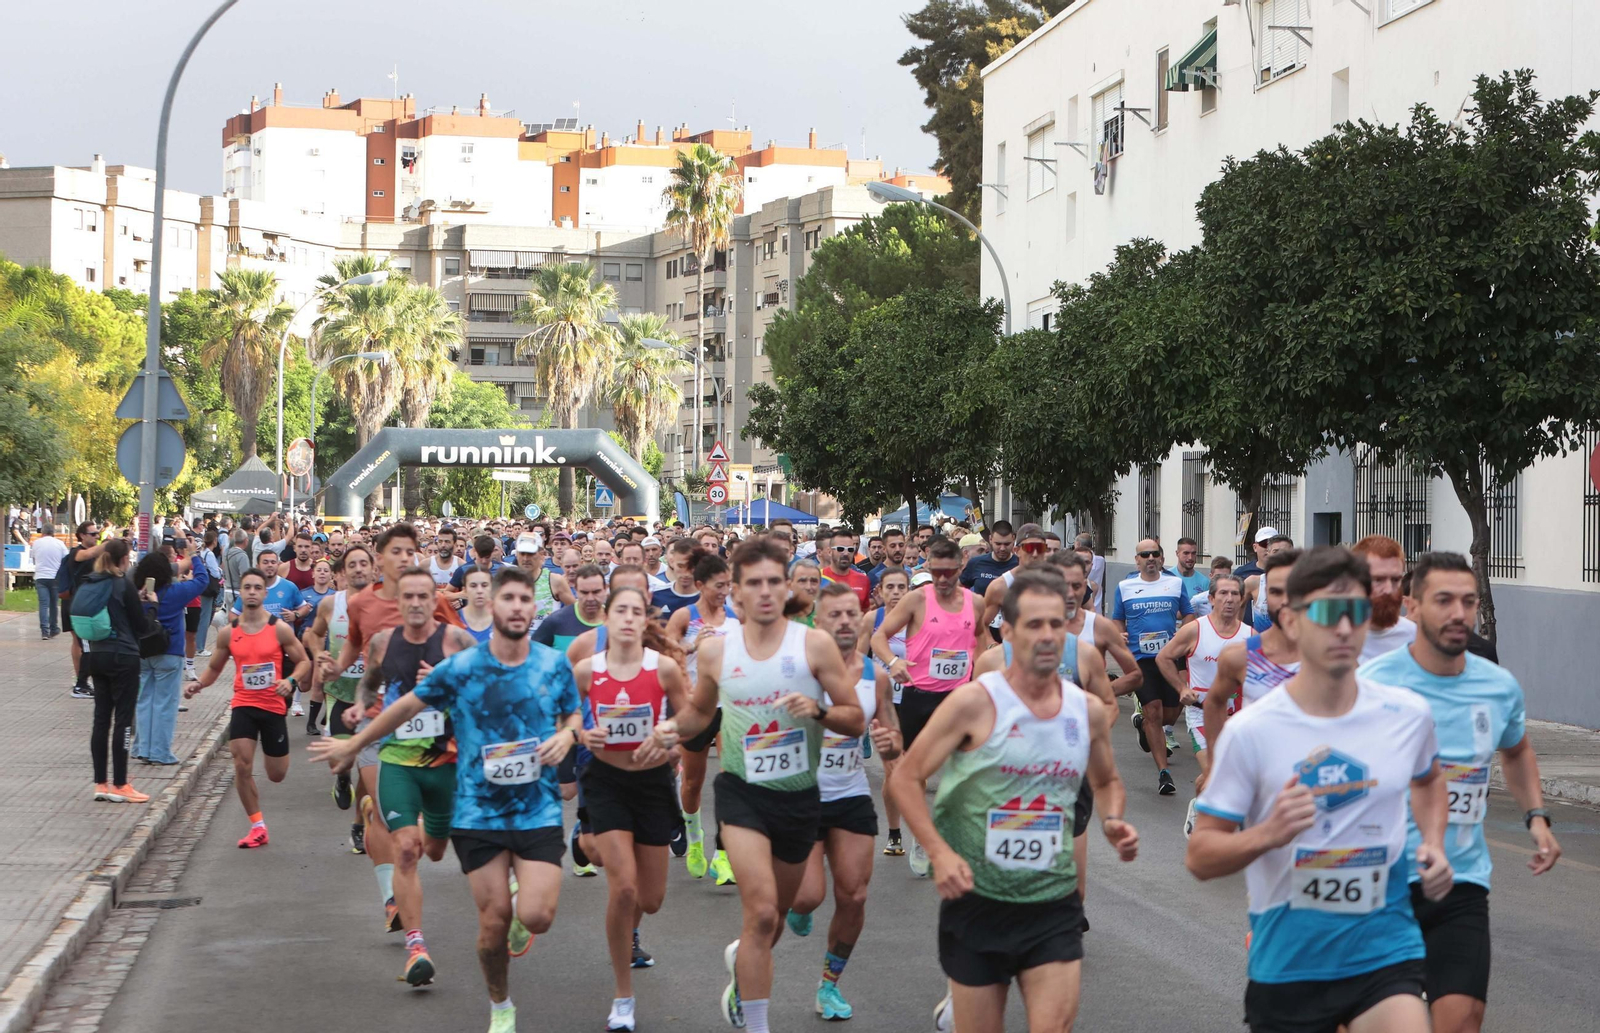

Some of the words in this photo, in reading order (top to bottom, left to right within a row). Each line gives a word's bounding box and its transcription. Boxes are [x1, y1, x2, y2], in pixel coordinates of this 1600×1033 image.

[421, 435, 566, 464] runnink.
[348, 449, 391, 490] runnink.com
[596, 450, 638, 489] runnink.com
[222, 487, 277, 495] runnink.
[712, 490, 723, 498] 30
[194, 500, 236, 509] runnink.
[1132, 601, 1172, 610] ESTUTIENDA
[1143, 641, 1161, 651] 191
[935, 663, 958, 675] 168
[246, 675, 266, 686] 428
[607, 722, 637, 737] 440
[492, 762, 525, 779] 262
[754, 753, 790, 773] 278
[1317, 763, 1350, 787] 5K
[996, 839, 1042, 860] 429
[1303, 877, 1362, 902] 426
